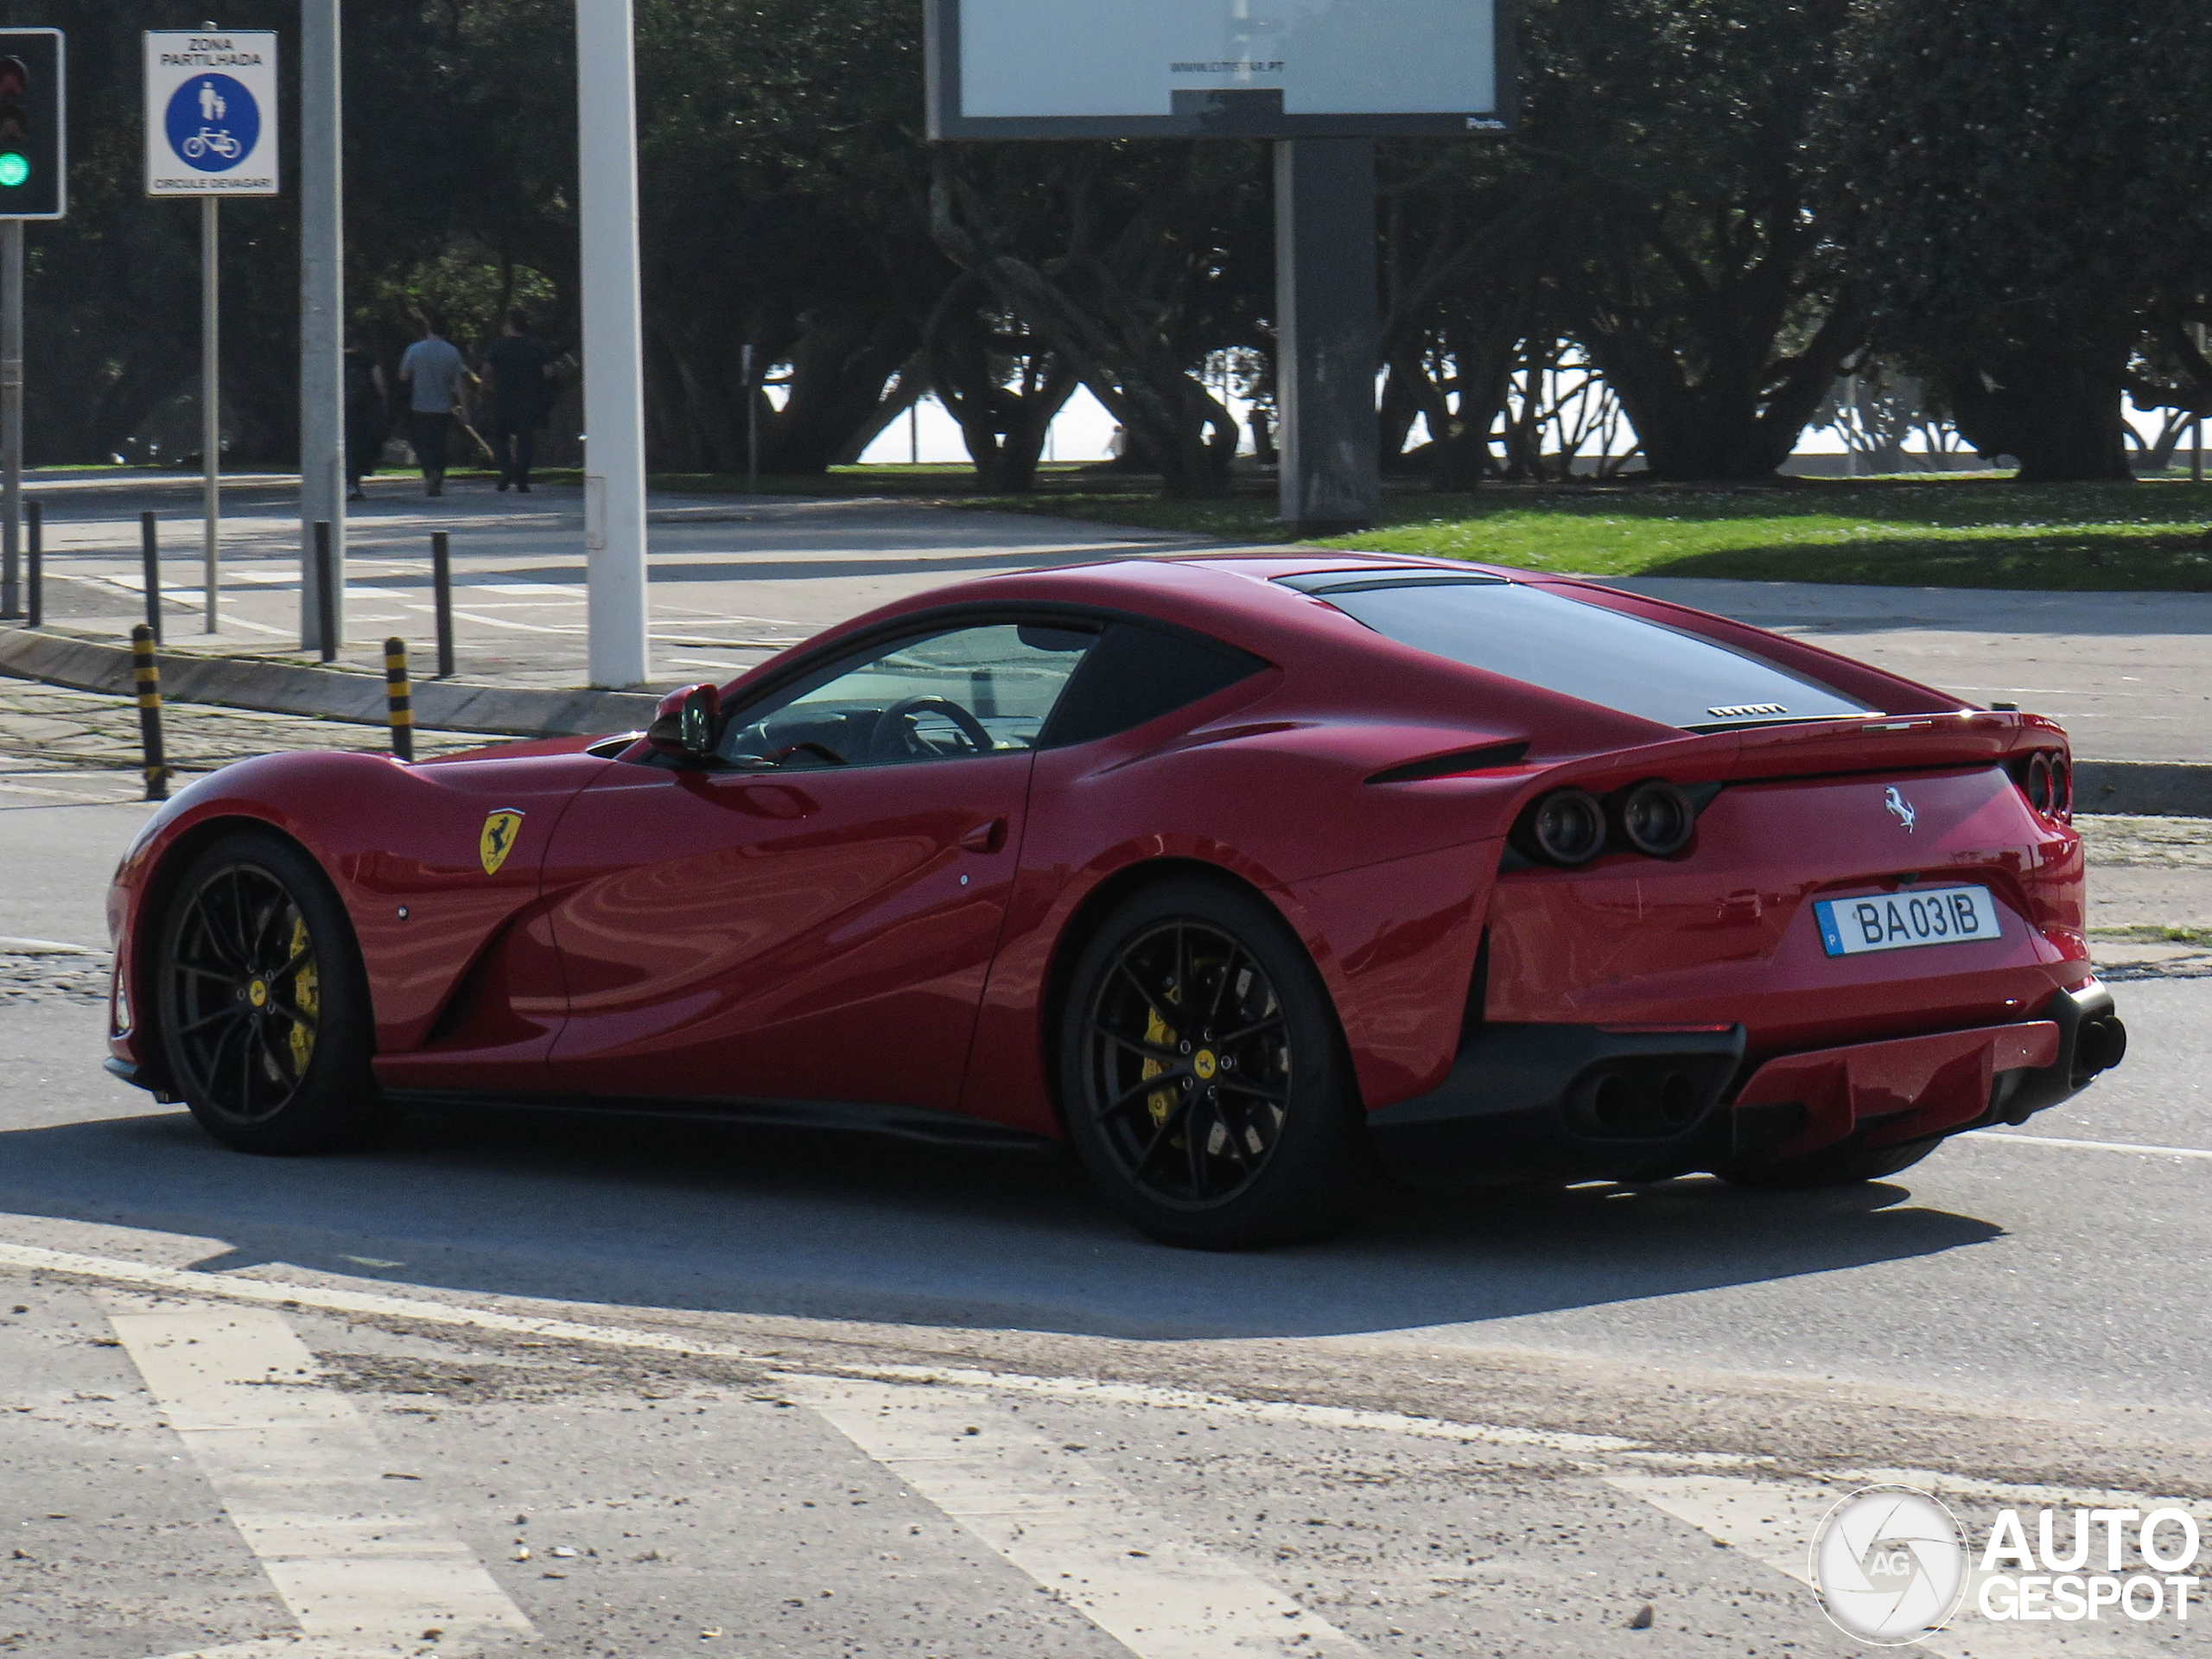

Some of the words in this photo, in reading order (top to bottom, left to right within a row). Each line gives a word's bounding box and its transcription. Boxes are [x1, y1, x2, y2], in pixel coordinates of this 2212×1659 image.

[188, 38, 233, 51] ZONA
[161, 53, 263, 66] PARTILHADA
[154, 178, 207, 188] CIRCULE
